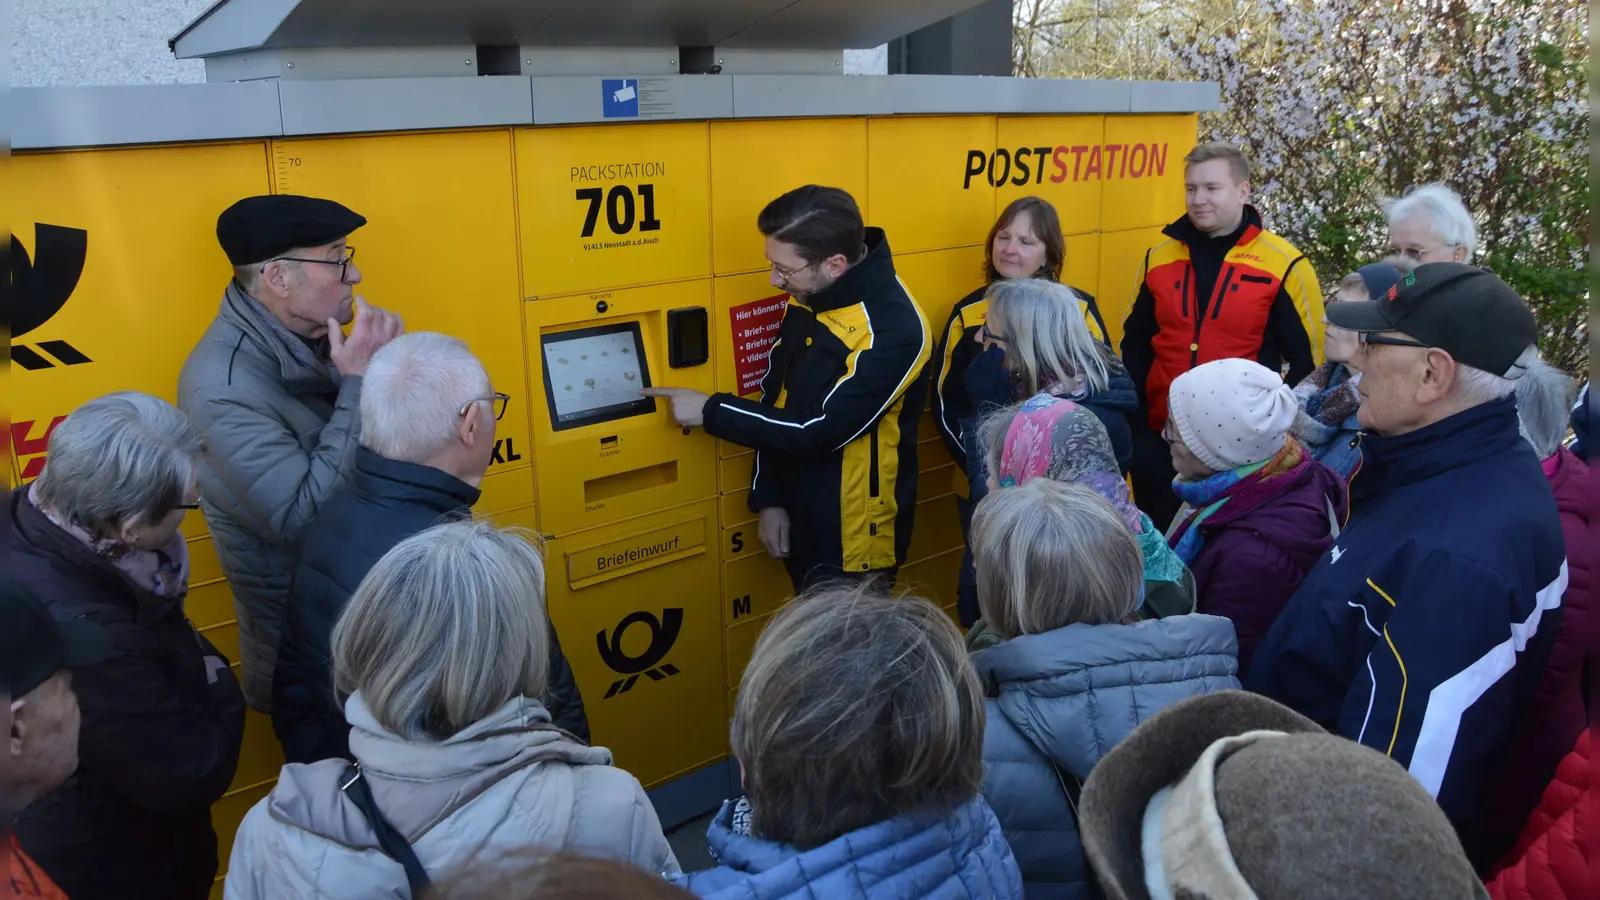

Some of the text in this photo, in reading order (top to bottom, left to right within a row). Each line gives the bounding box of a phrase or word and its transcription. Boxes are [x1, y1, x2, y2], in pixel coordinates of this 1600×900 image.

[288, 157, 302, 167] 70
[963, 142, 1169, 190] POSTSTATION
[569, 161, 666, 183] PACKSTATION
[575, 183, 661, 238] 701
[583, 242, 603, 251] 91413
[604, 239, 632, 249] Neustadt
[590, 292, 612, 301] Kamera
[736, 299, 789, 321] Hier können Si
[744, 327, 766, 338] Brief-
[766, 321, 780, 332] und
[745, 338, 768, 351] Briefe
[742, 371, 755, 380] Mehr
[488, 437, 521, 467] XL
[599, 449, 621, 458] Scanner
[585, 502, 606, 513] Drucker
[731, 531, 744, 553] S
[597, 535, 680, 571] Briefeinwurf
[732, 594, 752, 619] M
